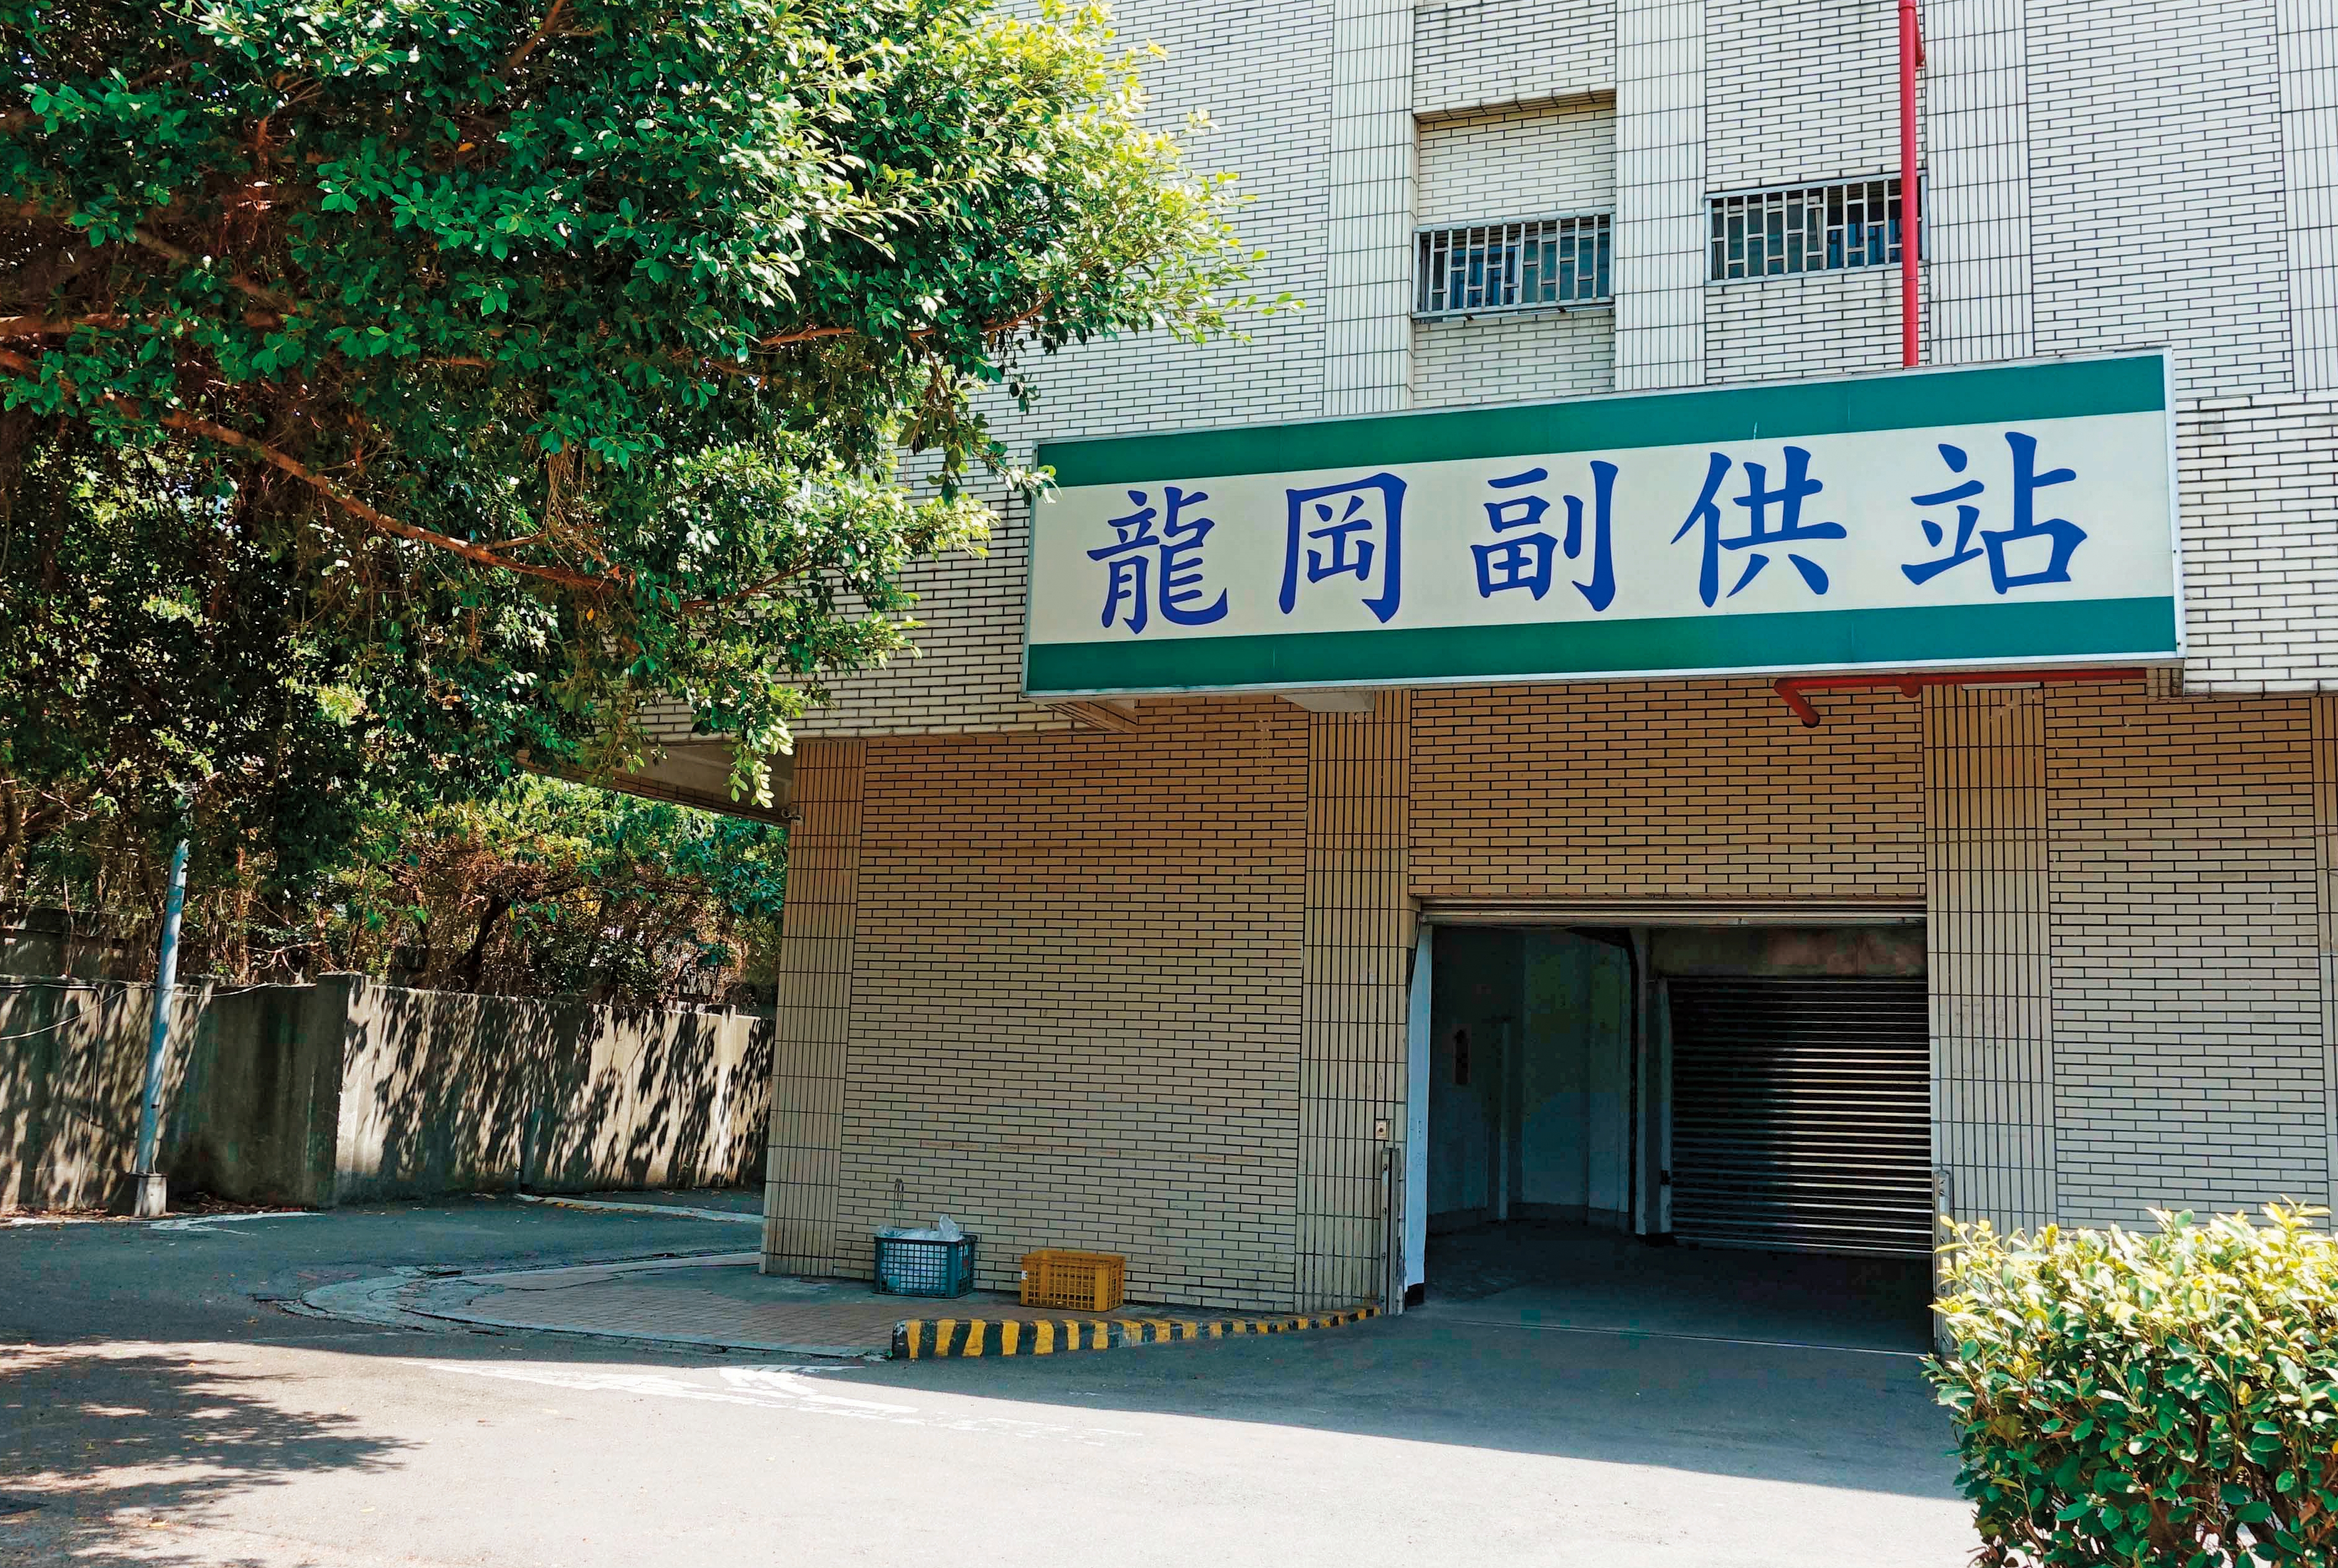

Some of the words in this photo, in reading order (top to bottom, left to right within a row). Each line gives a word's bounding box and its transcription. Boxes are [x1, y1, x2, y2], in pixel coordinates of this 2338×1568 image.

[1087, 431, 2088, 634] 龍岡副供站
